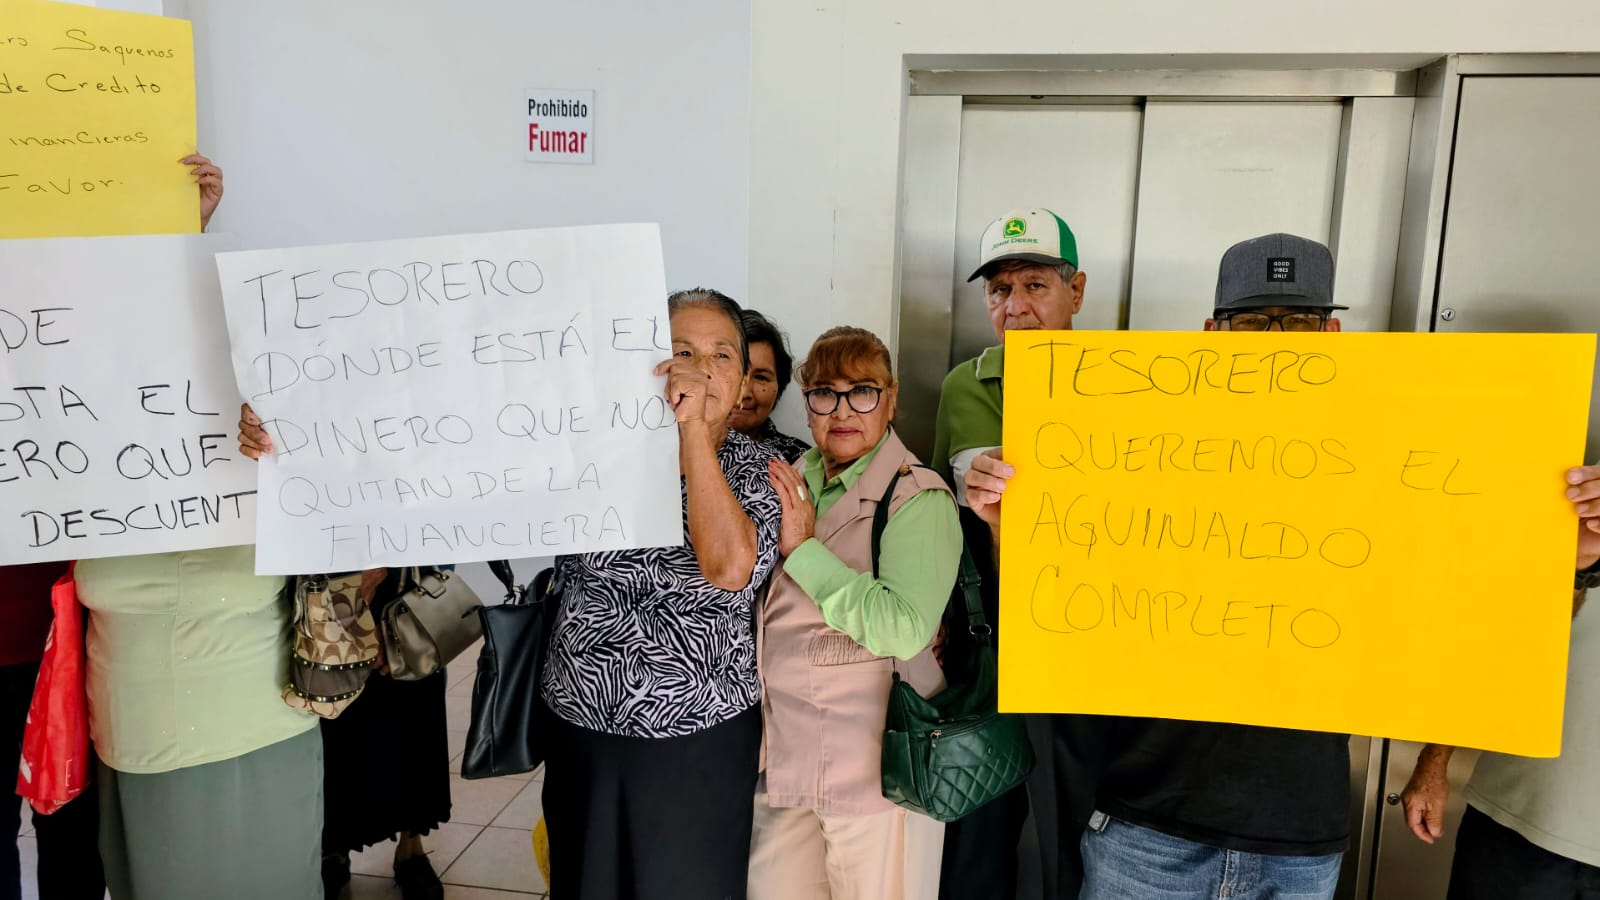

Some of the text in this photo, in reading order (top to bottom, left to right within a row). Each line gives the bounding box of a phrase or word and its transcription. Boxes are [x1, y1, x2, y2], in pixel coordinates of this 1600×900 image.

[0, 29, 174, 65] ro Saquenos
[0, 72, 160, 94] de Credito
[528, 98, 588, 118] Prohibido
[528, 122, 588, 154] Fumar
[243, 259, 544, 336] TESORERO
[252, 312, 671, 401] DÓNDE ESTÁ EL
[1027, 339, 1337, 399] TESORERO
[137, 379, 220, 416] EL
[116, 433, 231, 480] QUE
[260, 415, 474, 457] DINERO
[497, 403, 590, 441] QUE
[1035, 421, 1481, 495] QUEREMOS EL
[279, 462, 601, 517] QUITAN DE LA
[320, 505, 627, 567] FINANCIERA
[1029, 491, 1372, 568] AGUINALDO
[1030, 564, 1342, 648] COMPLETO
